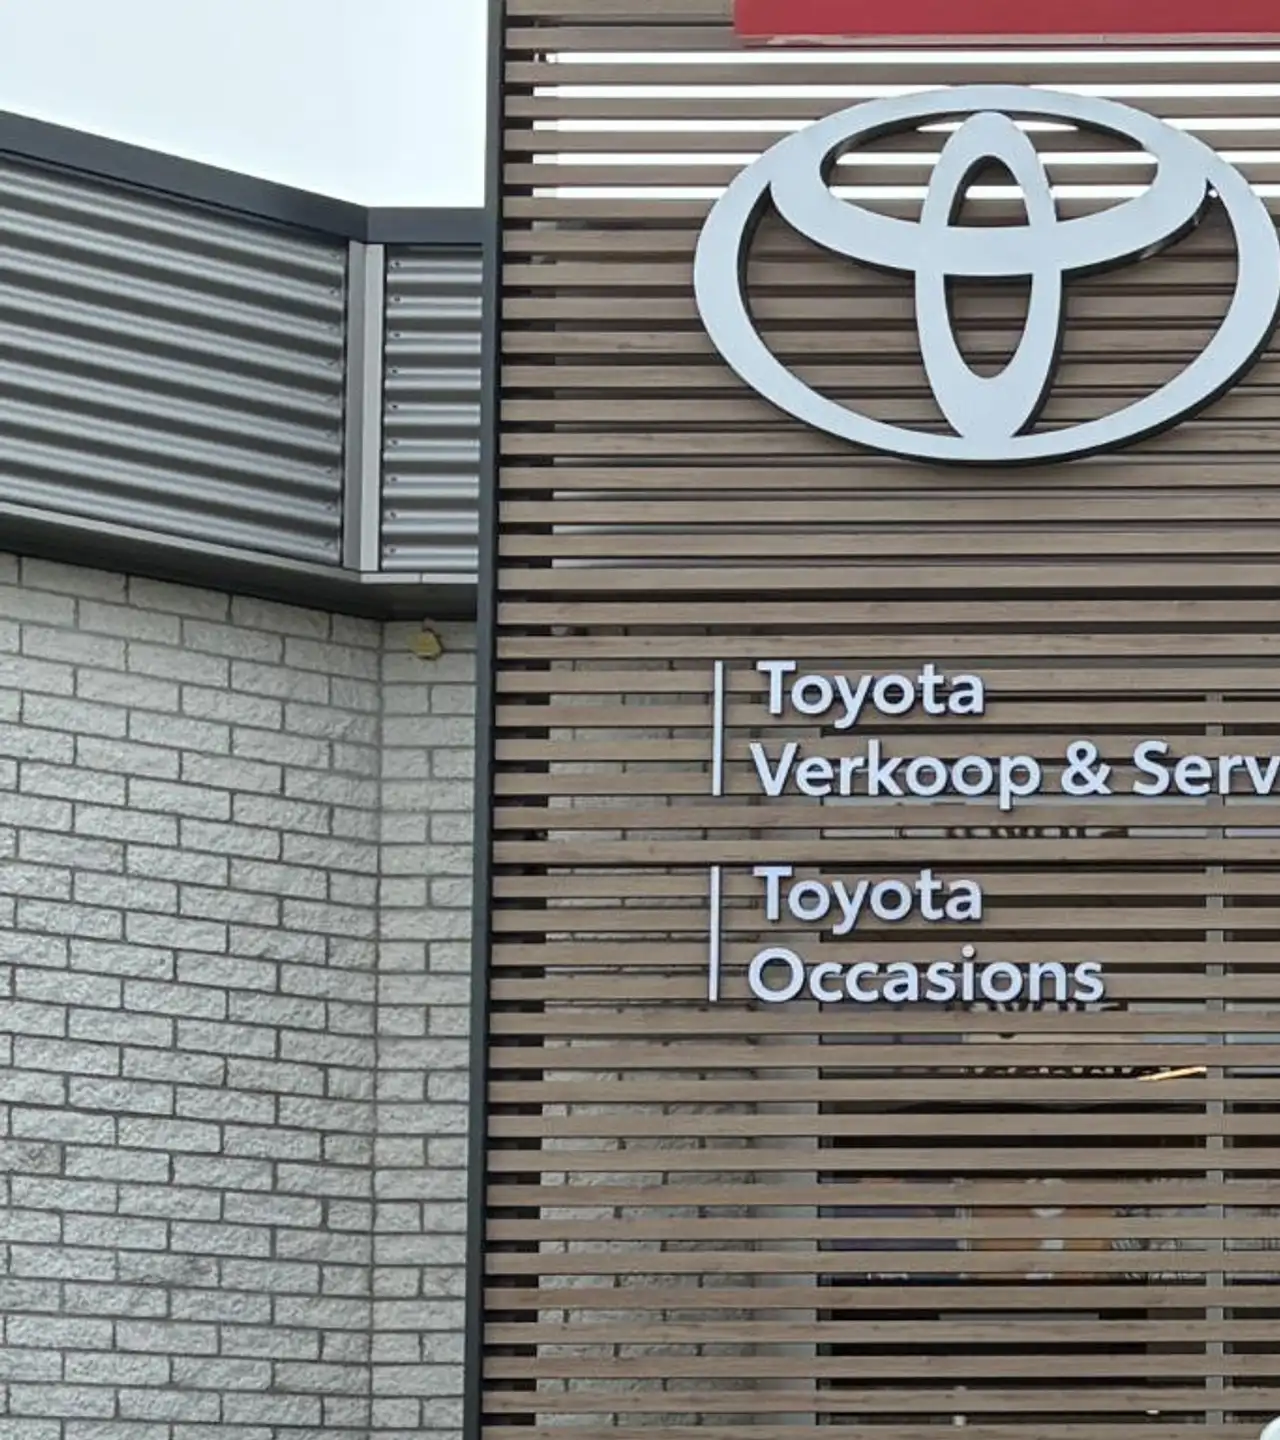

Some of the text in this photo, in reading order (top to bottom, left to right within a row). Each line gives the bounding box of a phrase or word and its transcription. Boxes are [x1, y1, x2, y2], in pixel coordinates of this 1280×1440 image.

[756, 660, 986, 728] Toyota
[751, 740, 1042, 811] Verkoop
[1061, 740, 1112, 796] &
[752, 865, 984, 934] Toyota
[748, 945, 1106, 1004] Occasions
